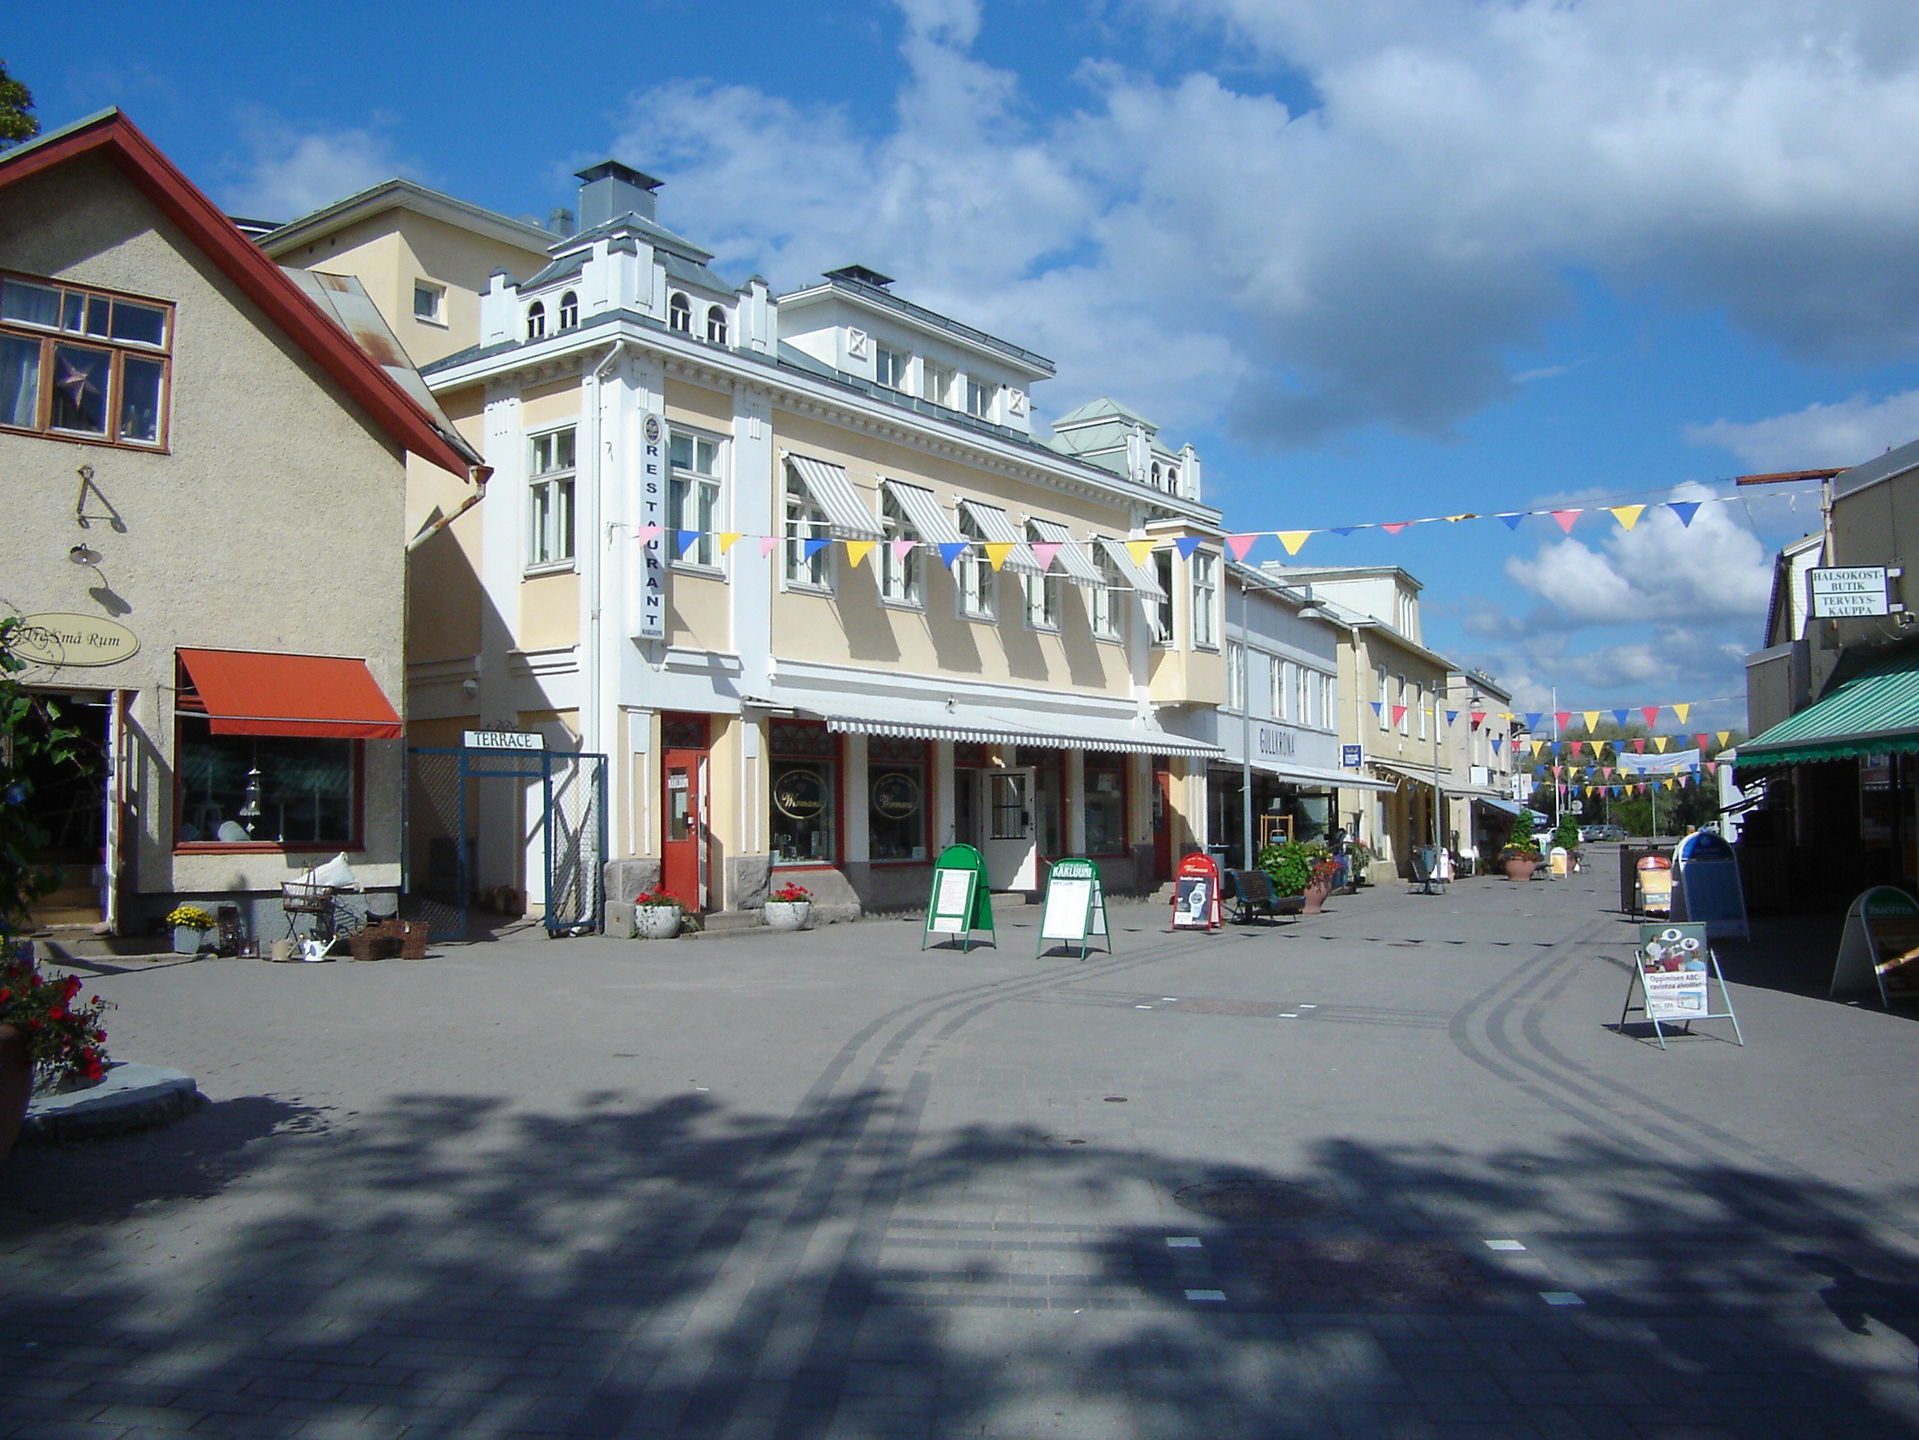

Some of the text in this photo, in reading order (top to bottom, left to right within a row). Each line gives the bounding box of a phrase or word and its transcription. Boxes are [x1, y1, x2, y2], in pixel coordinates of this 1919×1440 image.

[1831, 582, 1865, 592] BUTIK
[1823, 596, 1876, 606] TERVEYS-
[1828, 607, 1873, 616] KAUPPA
[87, 633, 120, 648] Rum
[473, 732, 533, 748] TERRACE
